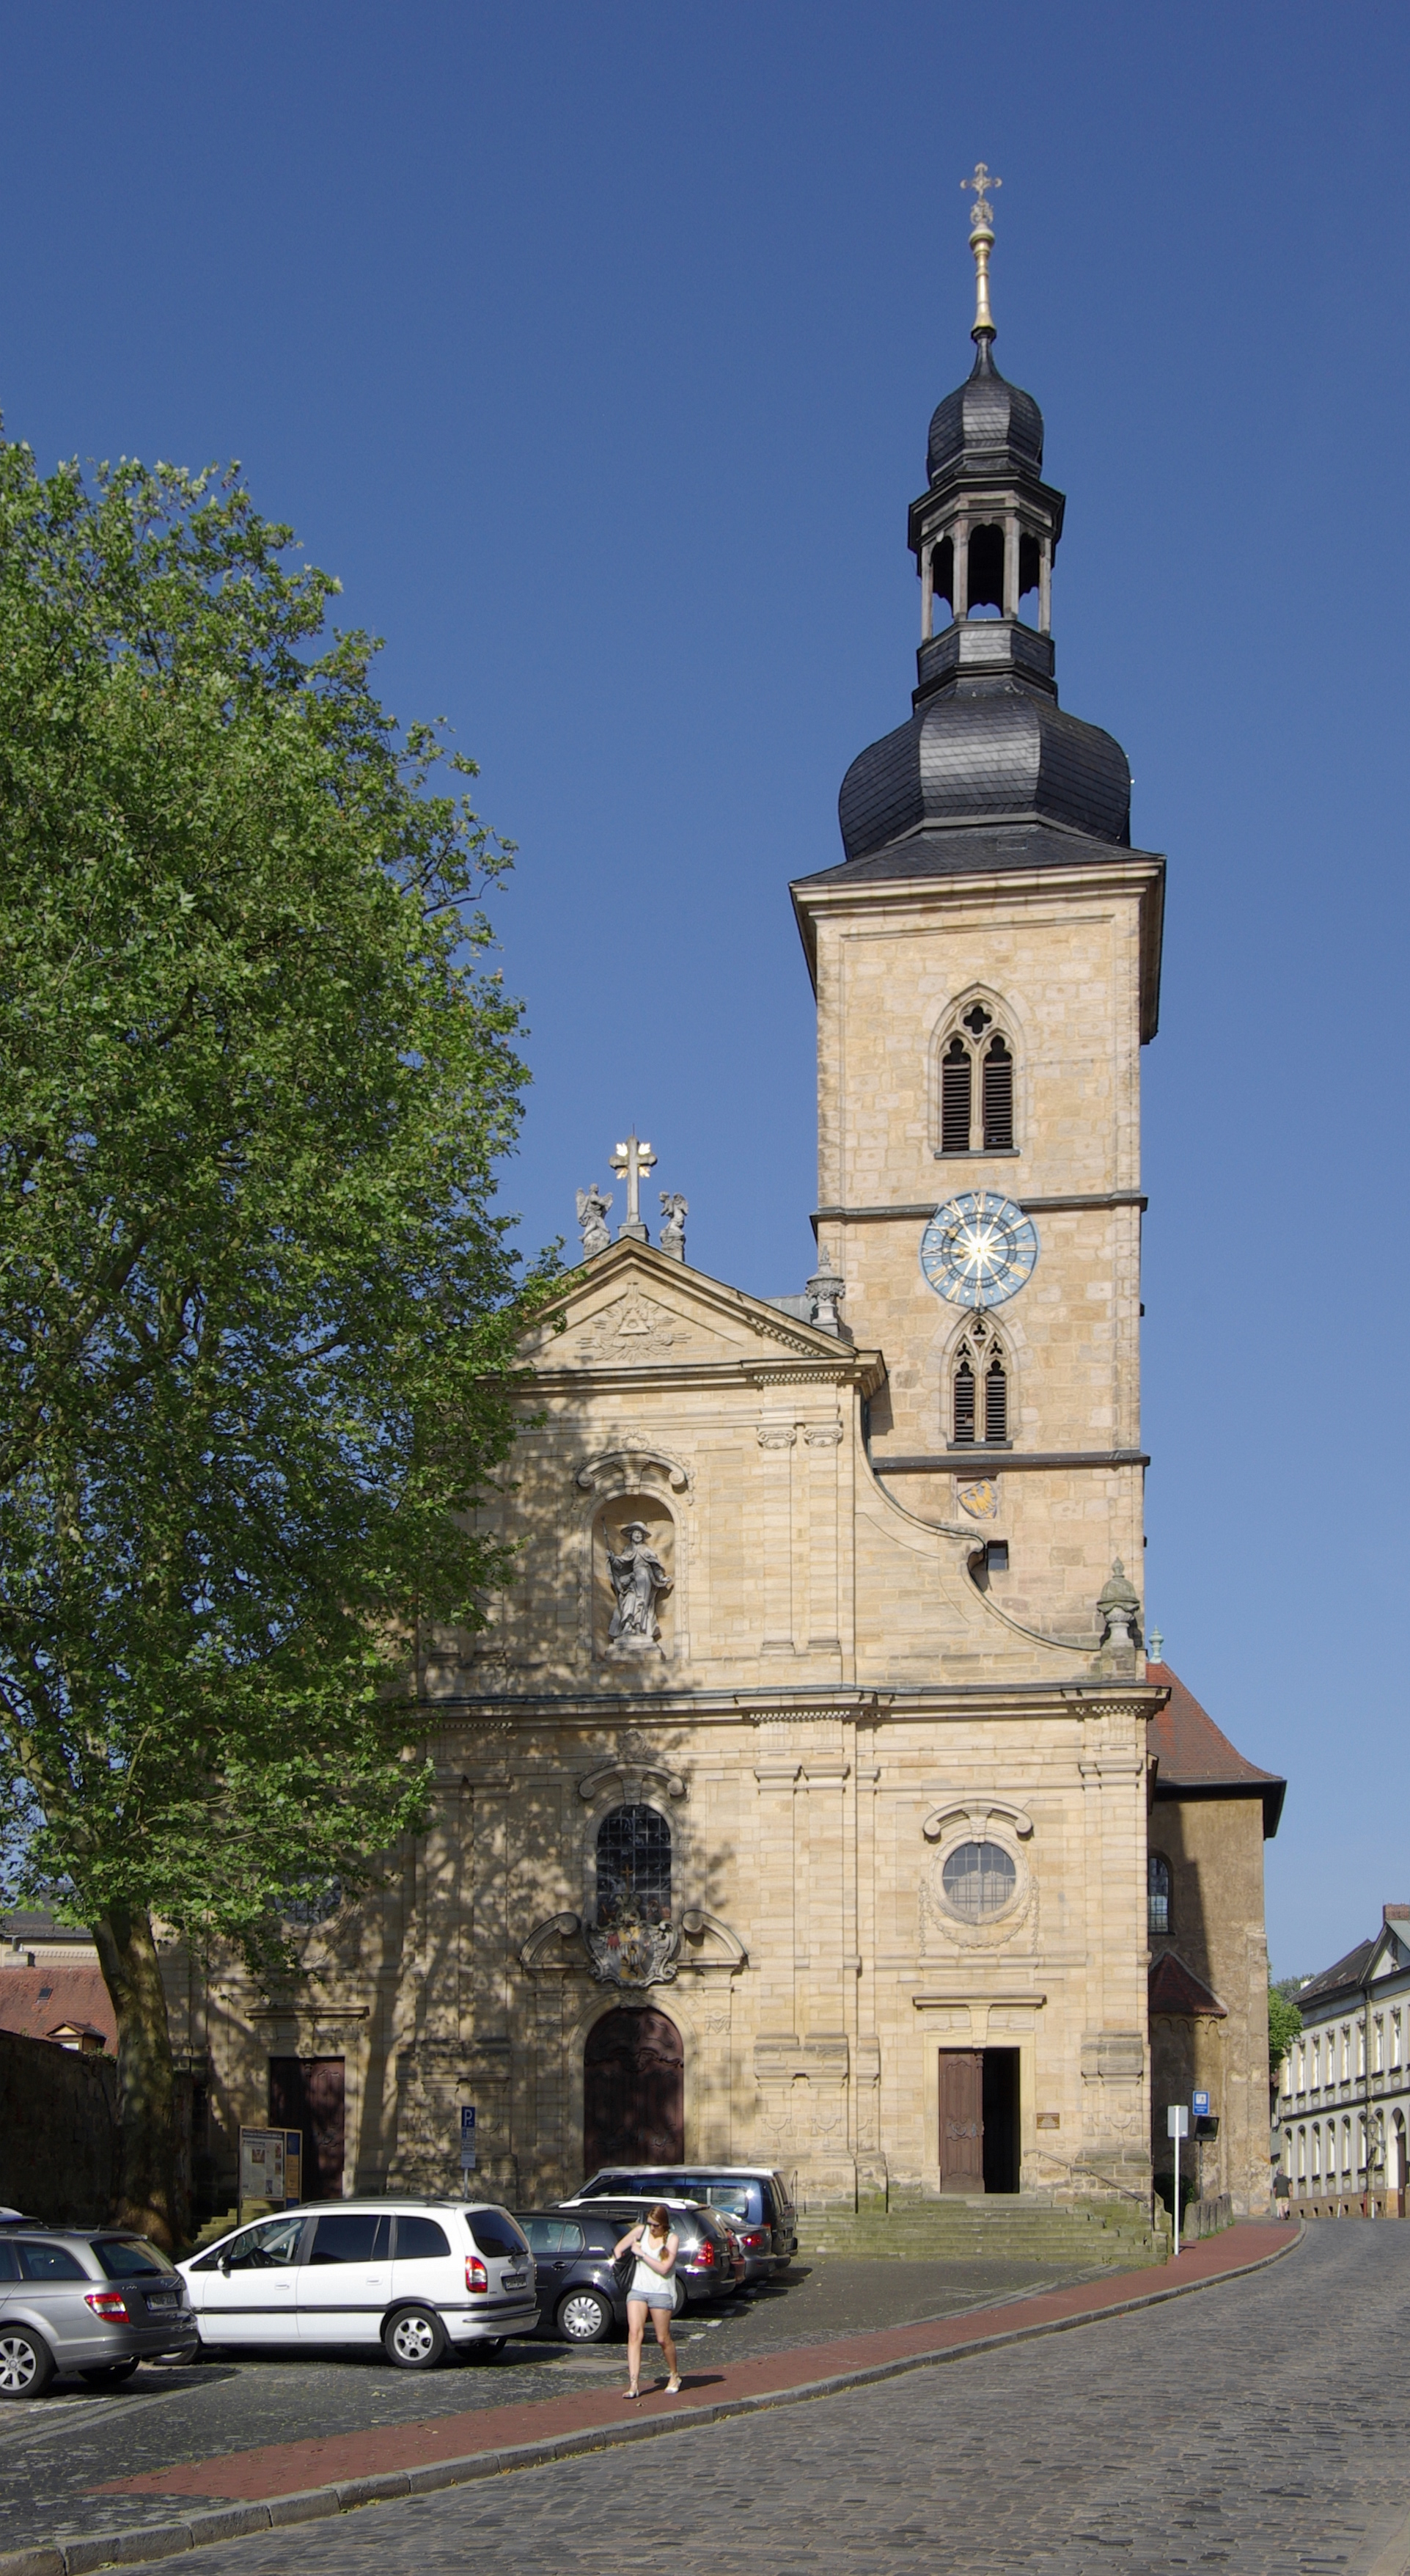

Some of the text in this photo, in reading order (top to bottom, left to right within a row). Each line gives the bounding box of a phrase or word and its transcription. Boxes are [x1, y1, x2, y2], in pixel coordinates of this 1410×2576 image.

[972, 1193, 987, 1214] XII
[997, 1198, 1008, 1217] I
[1011, 1216, 1029, 1231] II
[922, 1245, 943, 1257] IX
[1016, 1242, 1036, 1251] III
[946, 1280, 963, 1303] VII
[974, 1286, 987, 1307] VI
[996, 1280, 1013, 1300] V
[464, 2109, 473, 2126] P
